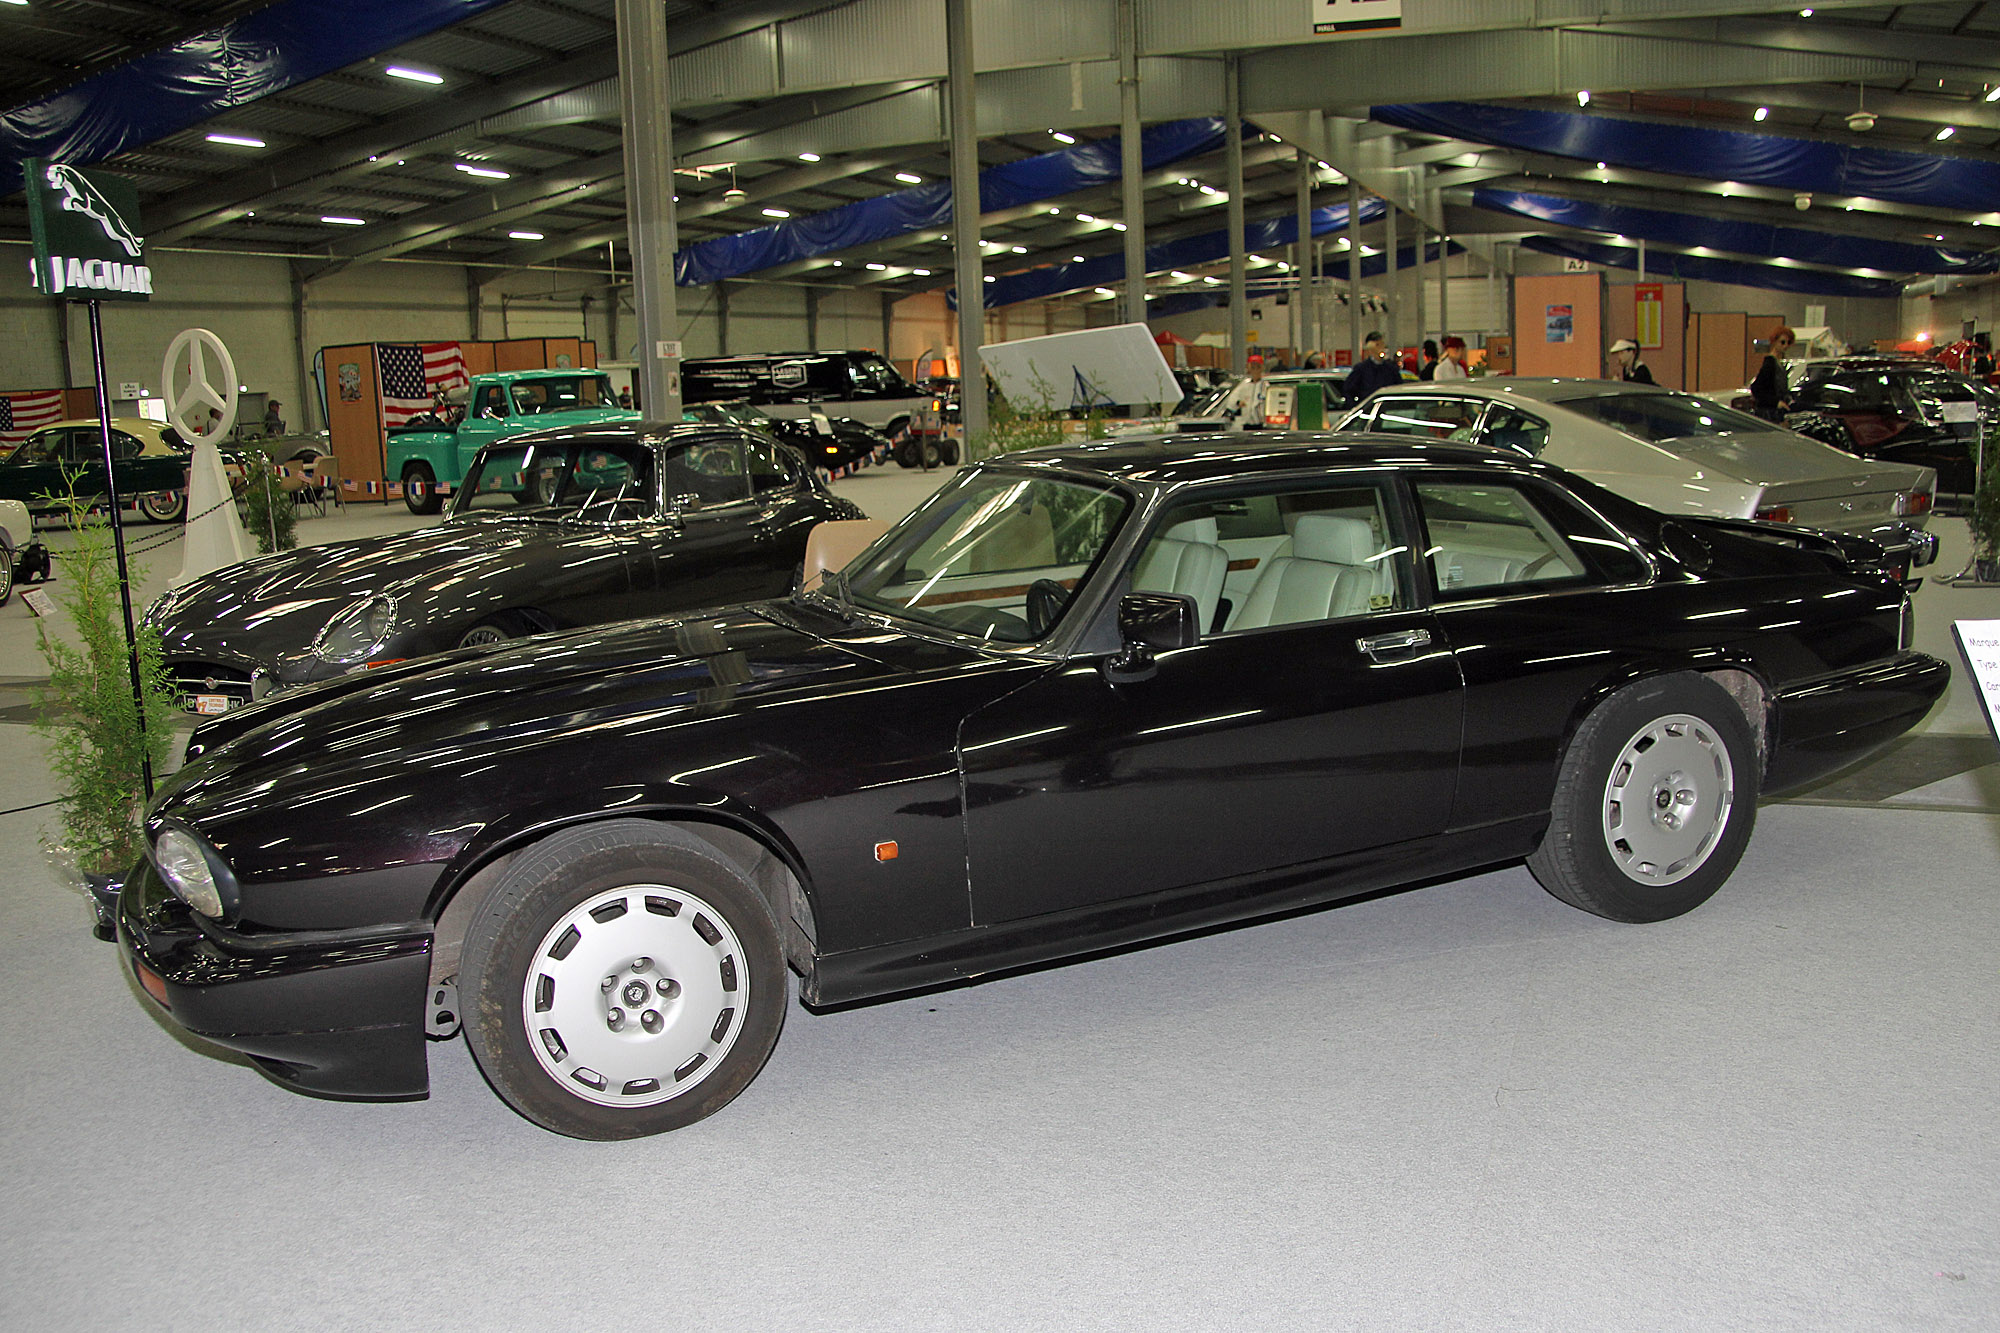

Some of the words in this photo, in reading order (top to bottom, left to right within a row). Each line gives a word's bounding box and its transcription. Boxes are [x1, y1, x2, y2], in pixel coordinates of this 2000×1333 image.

[51, 256, 154, 294] JAGUAR
[1969, 638, 2000, 649] Marque
[1976, 659, 1998, 671] Type
